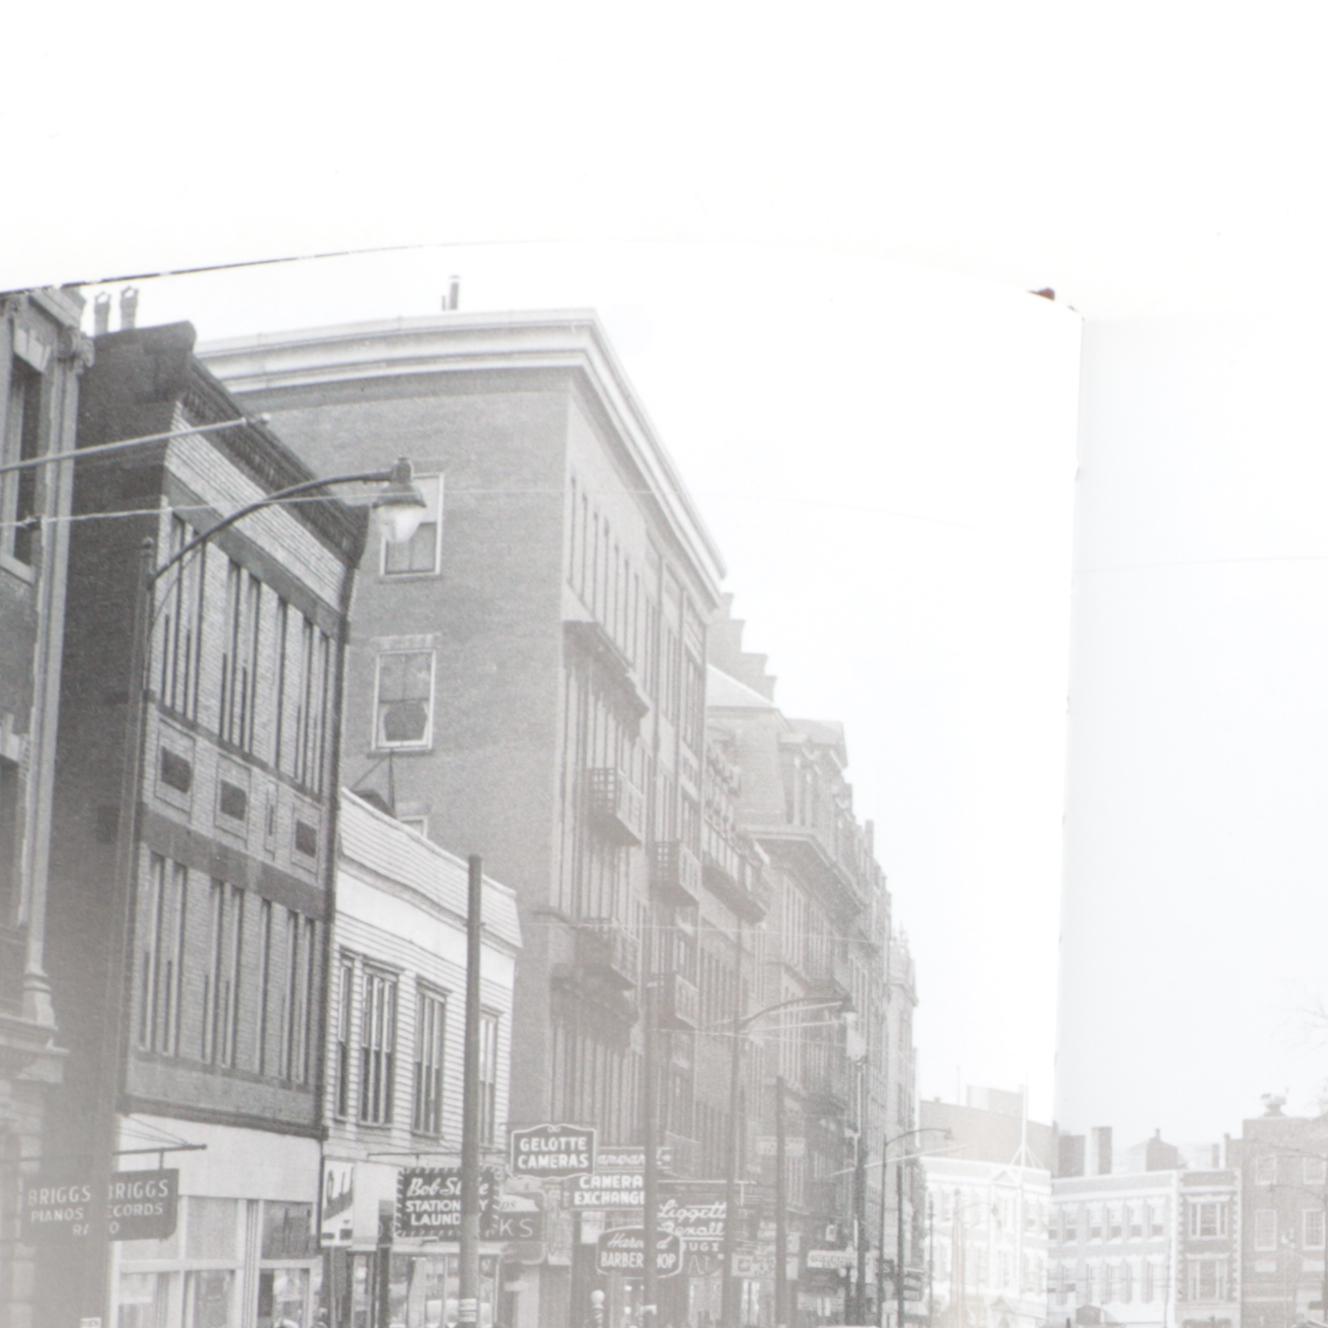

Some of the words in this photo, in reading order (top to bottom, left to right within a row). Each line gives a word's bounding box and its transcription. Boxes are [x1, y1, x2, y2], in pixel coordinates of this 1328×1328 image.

[520, 1137, 587, 1151] GELOTTE
[518, 1154, 589, 1168] CAMERAS
[406, 1177, 440, 1197] Bob
[579, 1175, 644, 1189] CAMERA
[28, 1184, 92, 1206] BRIGGS
[405, 1199, 489, 1213] STATIONY
[657, 1199, 727, 1222] Liggett
[31, 1207, 84, 1223] PIANOS
[411, 1213, 482, 1226] LAUND
[601, 1251, 645, 1268] BARBER
